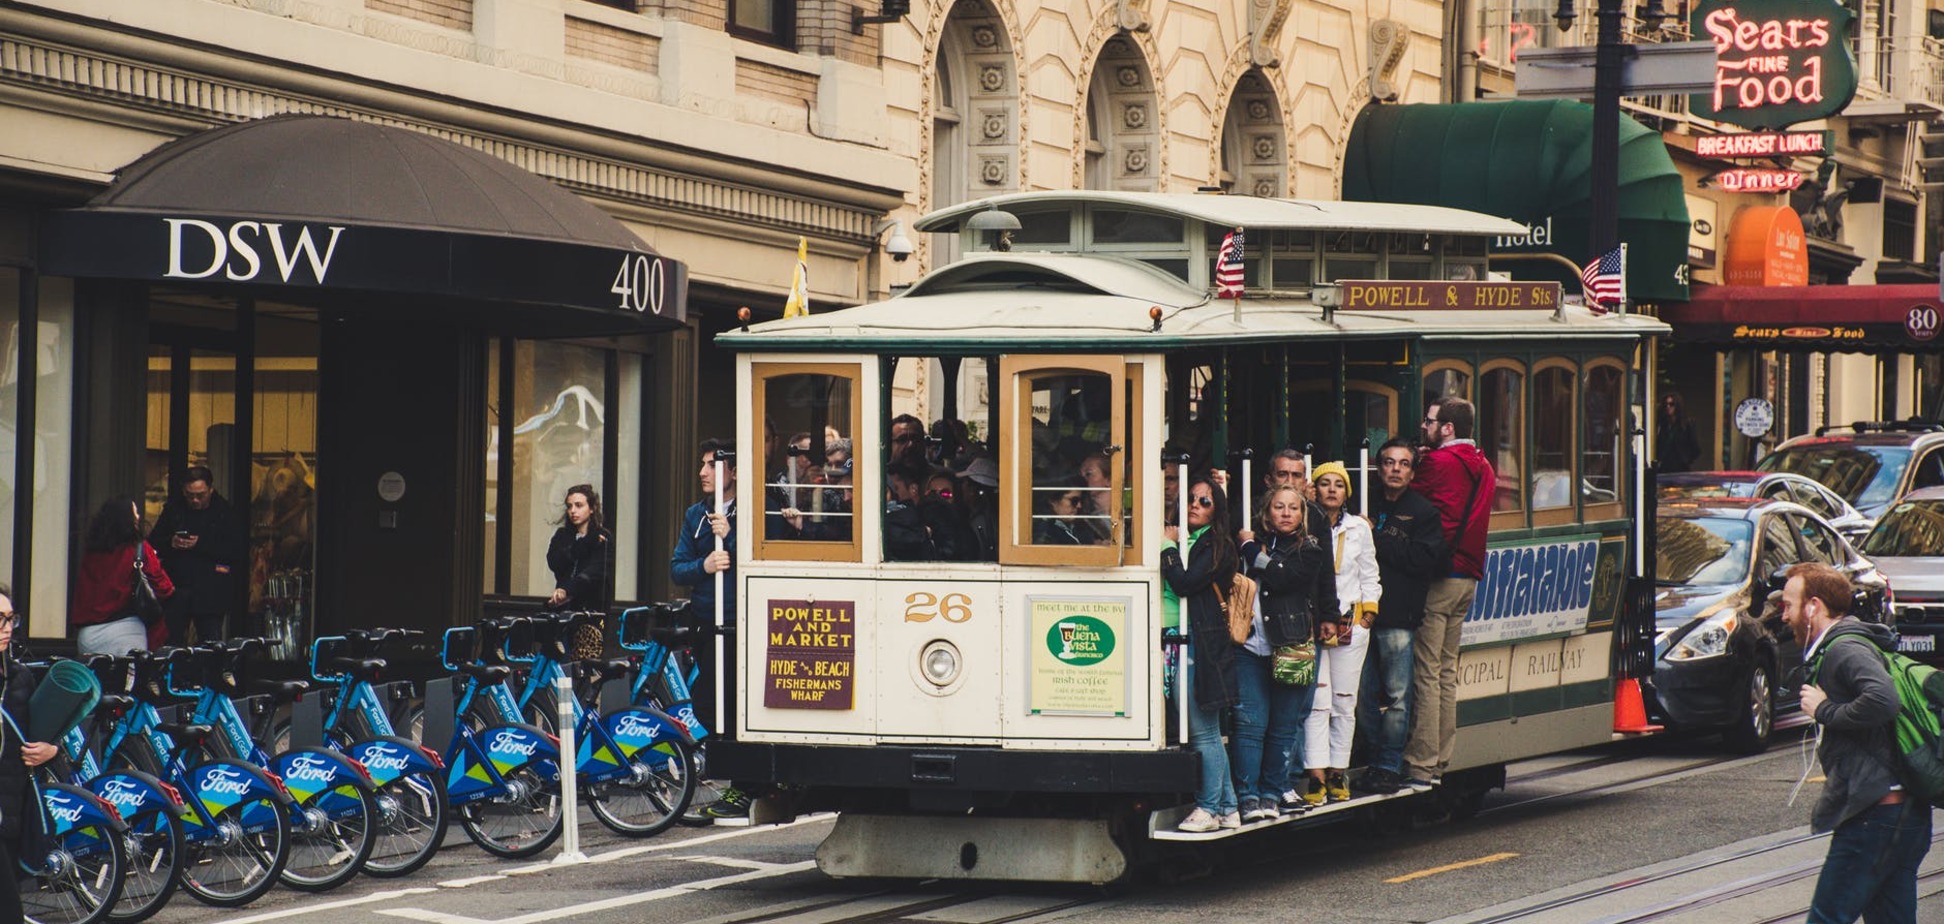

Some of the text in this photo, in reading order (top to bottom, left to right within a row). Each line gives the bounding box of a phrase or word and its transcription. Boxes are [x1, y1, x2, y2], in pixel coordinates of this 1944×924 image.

[1705, 7, 1829, 54] Sears
[1749, 55, 1789, 73] FINE
[1713, 56, 1823, 112] Food
[1697, 133, 1823, 155] BREAKFAST LUNCH
[163, 218, 346, 285] DSW
[611, 253, 664, 315] 400
[1349, 285, 1553, 306] POWELL & HYDE Sts.
[1909, 308, 1938, 330] 80
[1733, 325, 1780, 338] Sears
[1832, 327, 1865, 338] Food
[772, 607, 851, 622] POWELL
[904, 592, 973, 623] 26
[792, 622, 831, 632] AND
[770, 632, 852, 647] MARKET
[770, 660, 798, 675] HYDE
[814, 661, 850, 677] BEACH
[775, 678, 842, 690] FISHERMANS
[791, 690, 825, 701] WHARF
[615, 715, 660, 738] Ford
[490, 732, 538, 756] Ford
[286, 757, 337, 781] Ford
[360, 746, 410, 770] Ford
[99, 780, 147, 806] Ford
[201, 769, 252, 795] Ford
